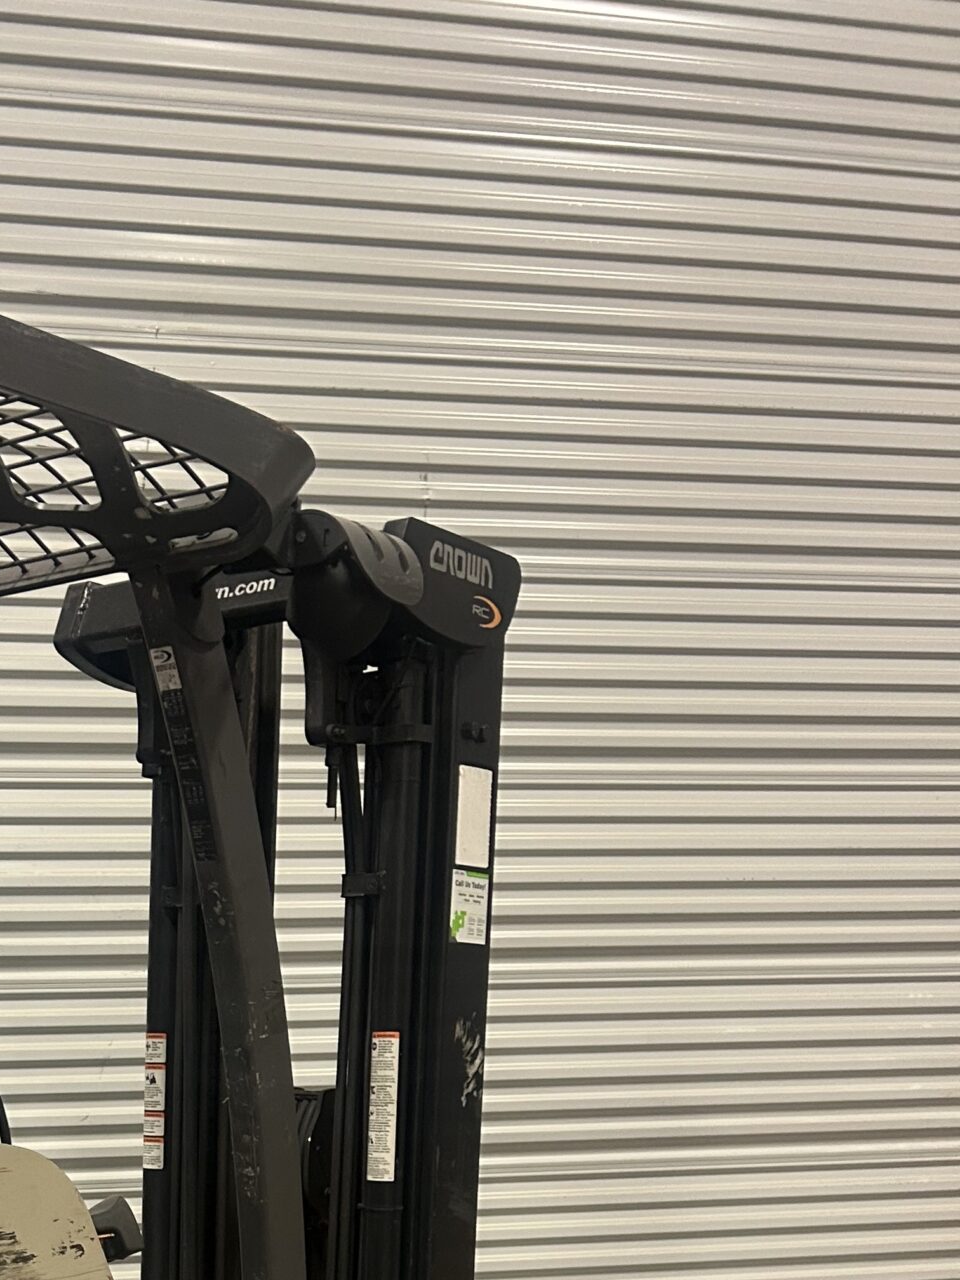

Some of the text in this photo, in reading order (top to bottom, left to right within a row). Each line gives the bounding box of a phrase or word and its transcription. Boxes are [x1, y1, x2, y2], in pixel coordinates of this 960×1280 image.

[429, 540, 493, 589] CROWN
[215, 577, 276, 600] n.com
[472, 604, 490, 619] RC
